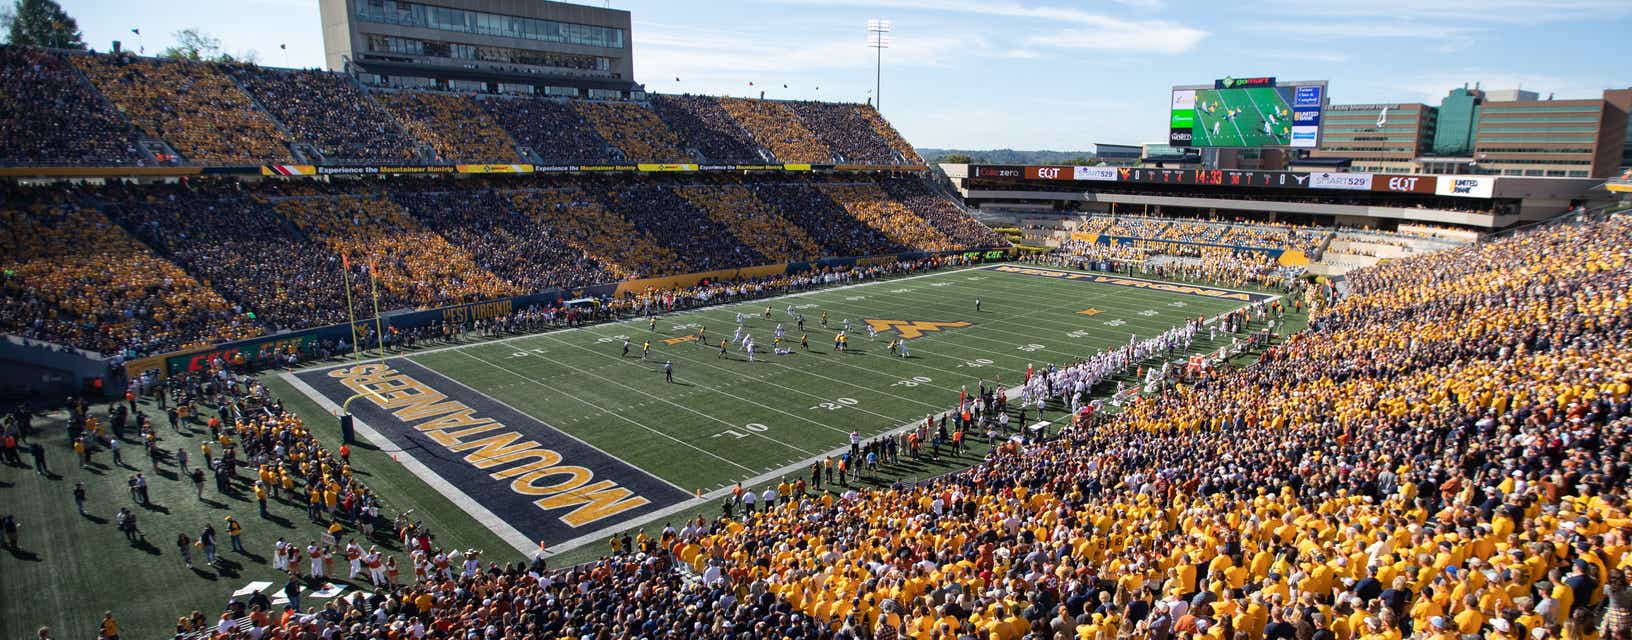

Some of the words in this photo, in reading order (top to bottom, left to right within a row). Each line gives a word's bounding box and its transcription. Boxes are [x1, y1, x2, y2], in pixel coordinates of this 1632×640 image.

[318, 166, 363, 175] Experience
[365, 166, 379, 174] the
[380, 166, 425, 174] Mountaineer
[1039, 168, 1060, 179] EQT
[1195, 169, 1223, 185] 14:33
[1388, 177, 1419, 191] EQT
[817, 396, 859, 411] 20
[327, 362, 652, 529] MOUNTAINEERS
